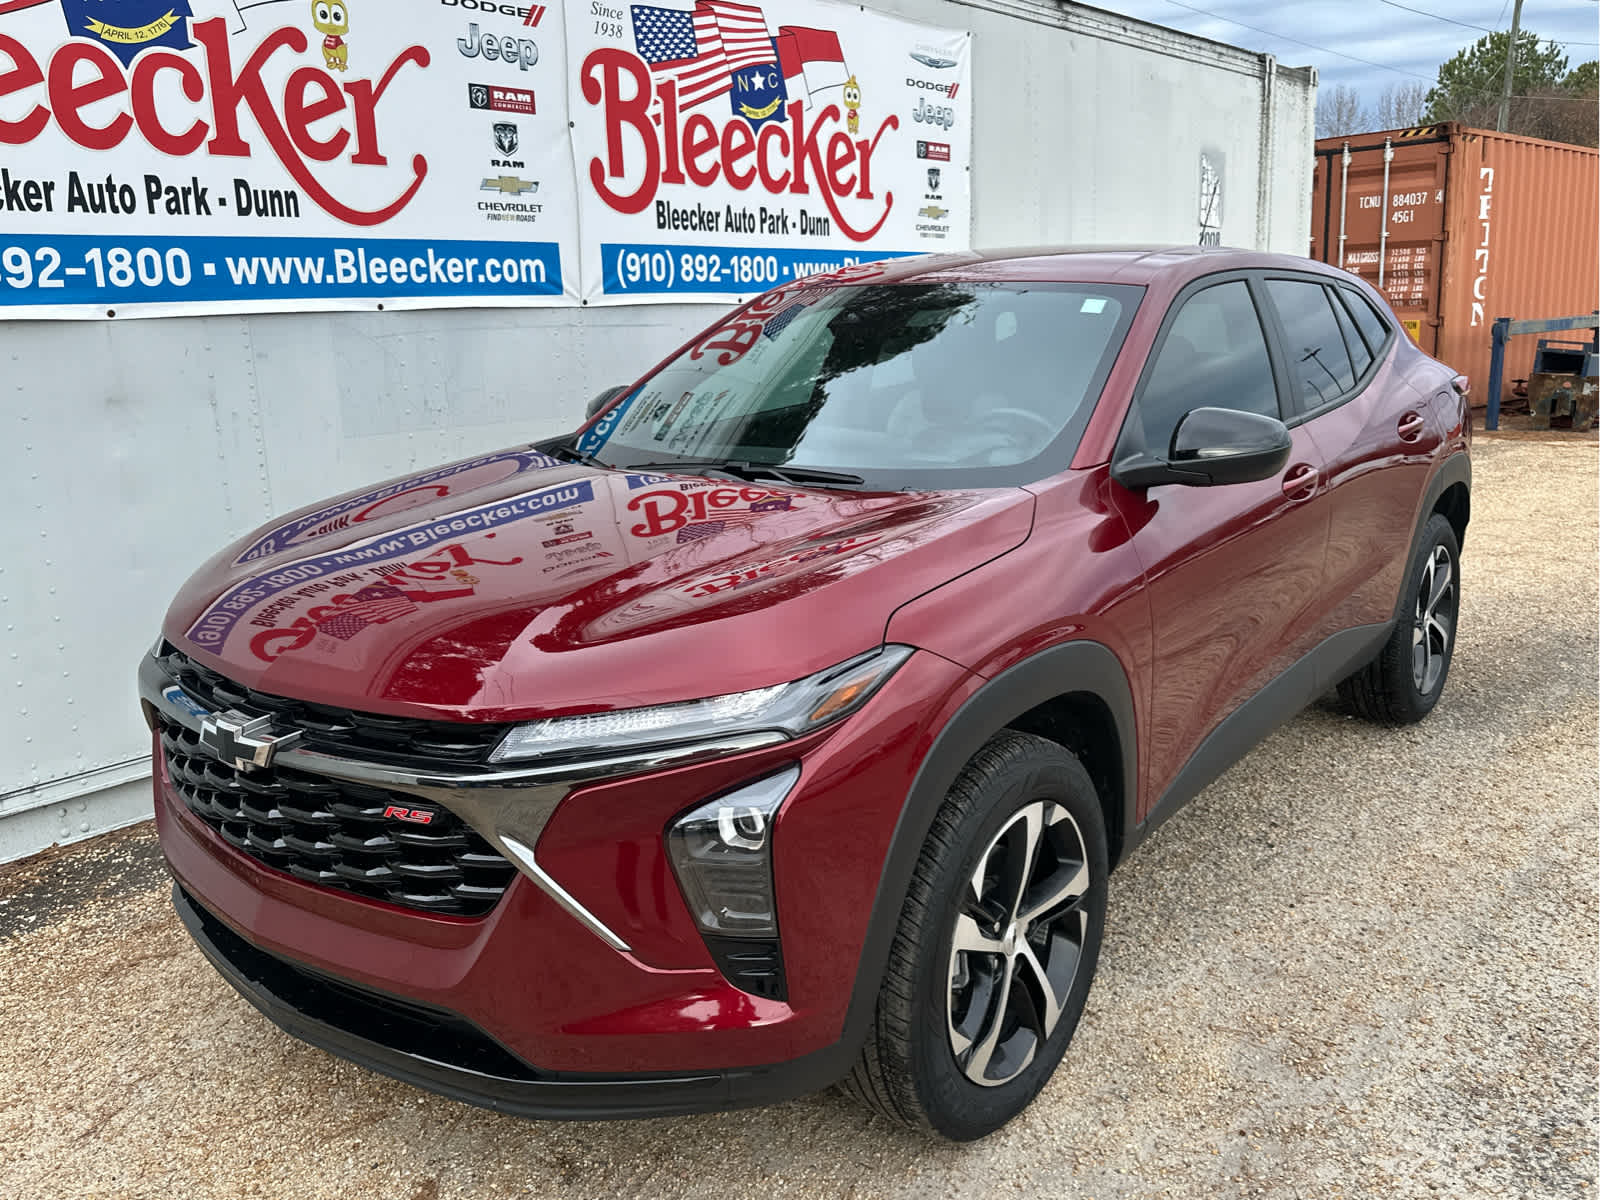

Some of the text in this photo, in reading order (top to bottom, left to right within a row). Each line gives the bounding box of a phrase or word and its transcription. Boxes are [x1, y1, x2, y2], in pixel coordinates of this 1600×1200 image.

[590, 1, 623, 20] Since
[103, 28, 132, 40] APRIL
[148, 20, 167, 35] 1776
[594, 21, 623, 39] 1938
[456, 22, 538, 71] Jeep
[737, 72, 778, 92] N C
[906, 78, 952, 93] DODGE
[493, 90, 531, 102] RAM
[494, 102, 532, 111] COMMERCIAL
[913, 97, 954, 131] Jeep
[581, 47, 899, 242] Bleecker
[491, 159, 525, 168] RAM
[67, 171, 136, 214] Auto
[144, 174, 212, 216] Park
[233, 178, 300, 218] Dunn
[1360, 196, 1381, 208] TCNU
[1392, 192, 1427, 207] 884037
[477, 202, 543, 213] CHEVROLET
[656, 200, 831, 236] Bleecker Auto Park Dunn
[1392, 210, 1414, 224] 45G1
[915, 224, 950, 232] CHEVROLET
[0, 246, 546, 289] 92-1800 www.Bleecker.com
[617, 249, 675, 288] (910)
[680, 254, 778, 283] 892-1800
[384, 806, 434, 824] RS
